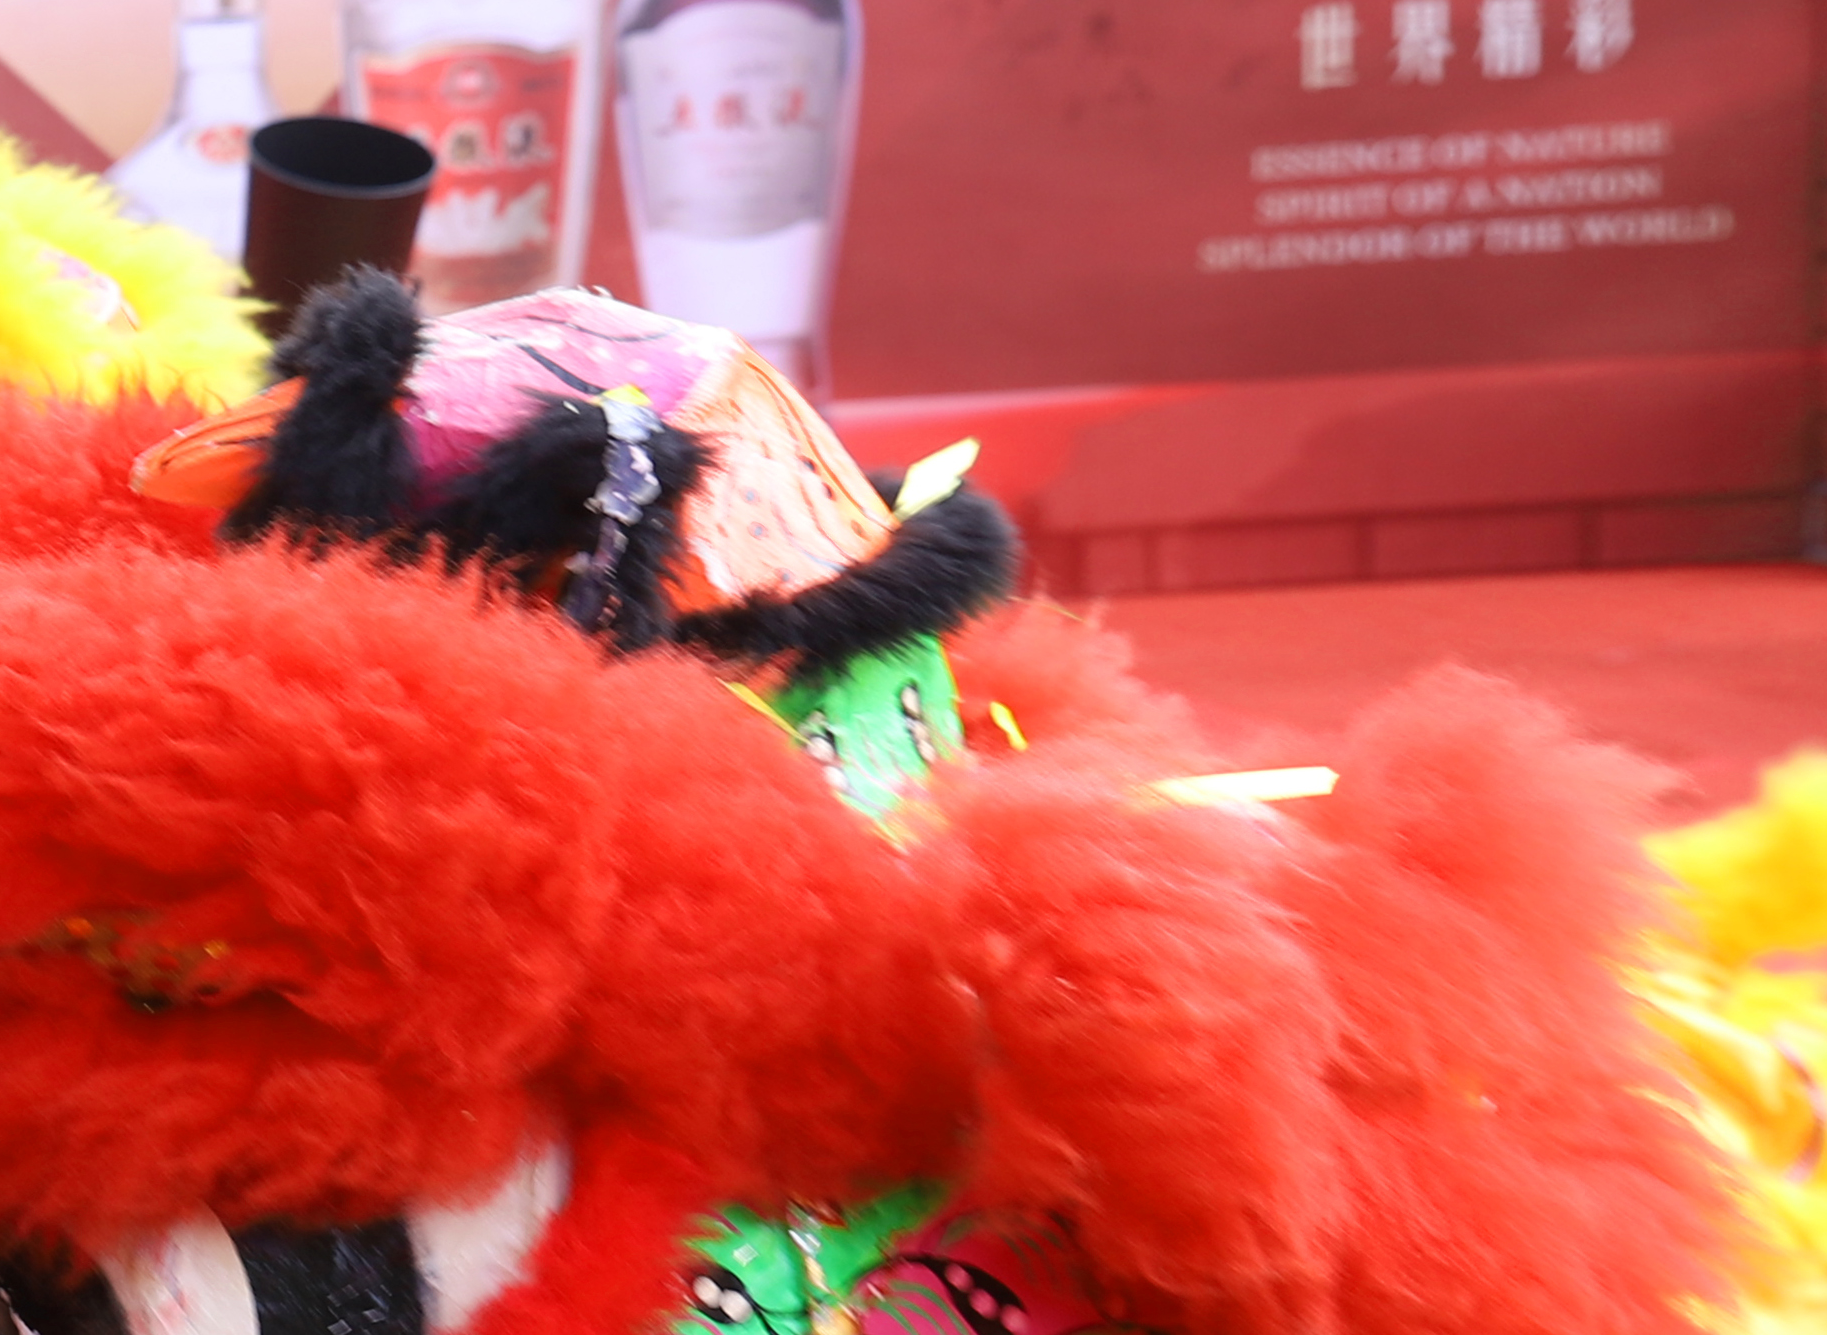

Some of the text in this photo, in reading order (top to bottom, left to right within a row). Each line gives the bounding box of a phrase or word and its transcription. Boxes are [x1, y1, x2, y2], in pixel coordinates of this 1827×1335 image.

[1250, 120, 1671, 181] ESSENCE OF NATURE
[1255, 183, 1388, 224] SPIRIT
[1391, 177, 1456, 216] OF
[1495, 164, 1663, 207] NATION
[1197, 204, 1735, 272] SPLENDOR OF THE WORLD
